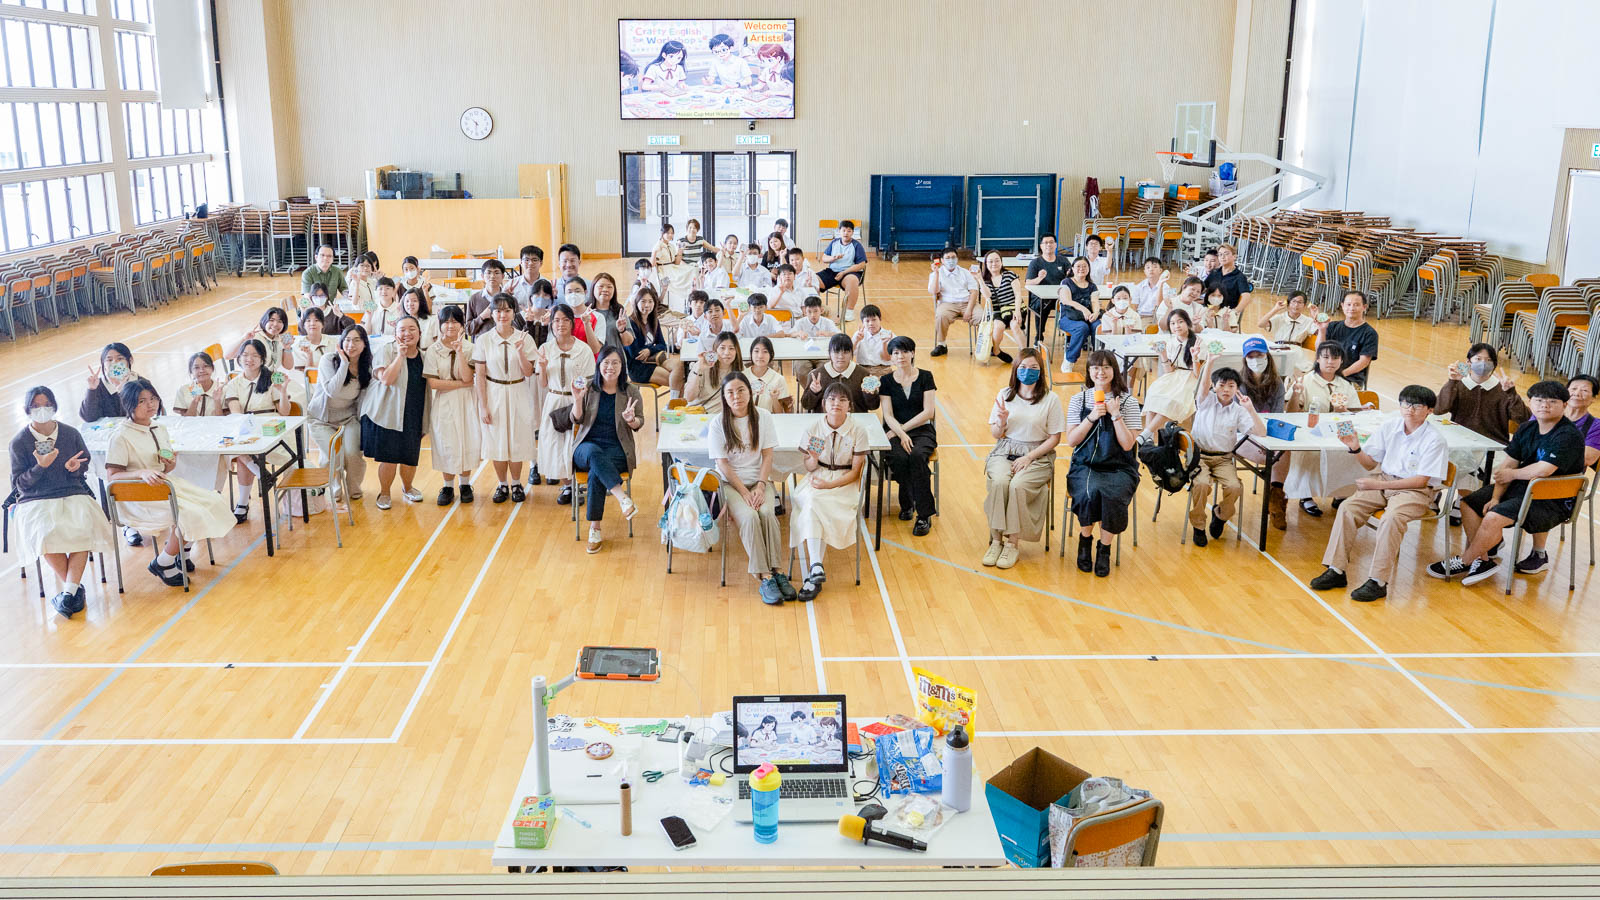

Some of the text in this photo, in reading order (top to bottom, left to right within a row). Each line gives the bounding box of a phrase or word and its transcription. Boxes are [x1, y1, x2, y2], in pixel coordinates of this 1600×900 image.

[743, 21, 788, 31] Welcome
[634, 27, 702, 37] Crafty English
[750, 33, 784, 42] Artists!
[650, 136, 677, 145] EXIT 出口
[737, 135, 769, 144] EXIT 出口
[1593, 144, 1600, 157] E
[957, 692, 974, 704] fun
